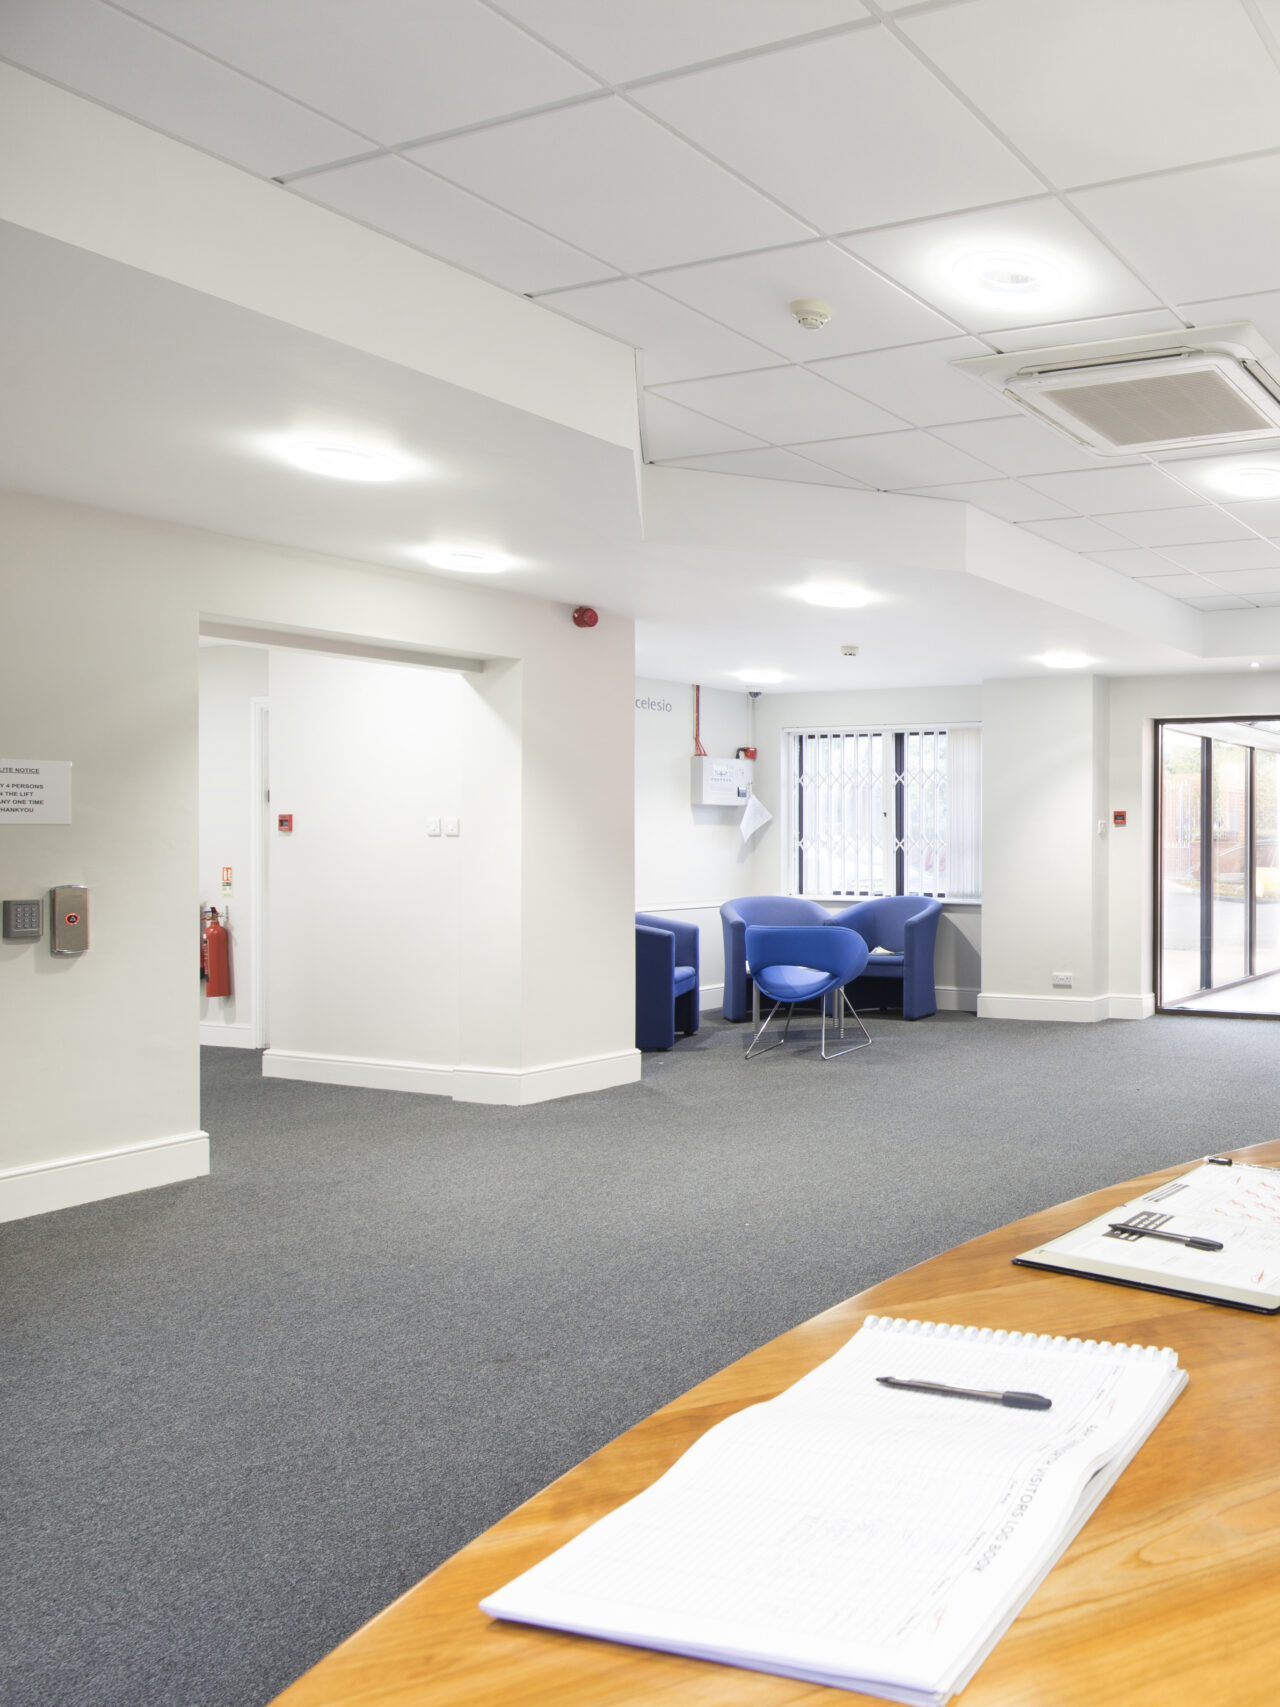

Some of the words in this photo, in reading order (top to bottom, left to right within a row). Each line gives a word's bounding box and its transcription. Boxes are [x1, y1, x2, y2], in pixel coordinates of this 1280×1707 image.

[634, 697, 673, 713] celesio
[15, 767, 40, 775] NOTICE
[1011, 1466, 1047, 1519] VISITORS
[994, 1519, 1018, 1543] LOG
[974, 1542, 1002, 1573] BOOK
